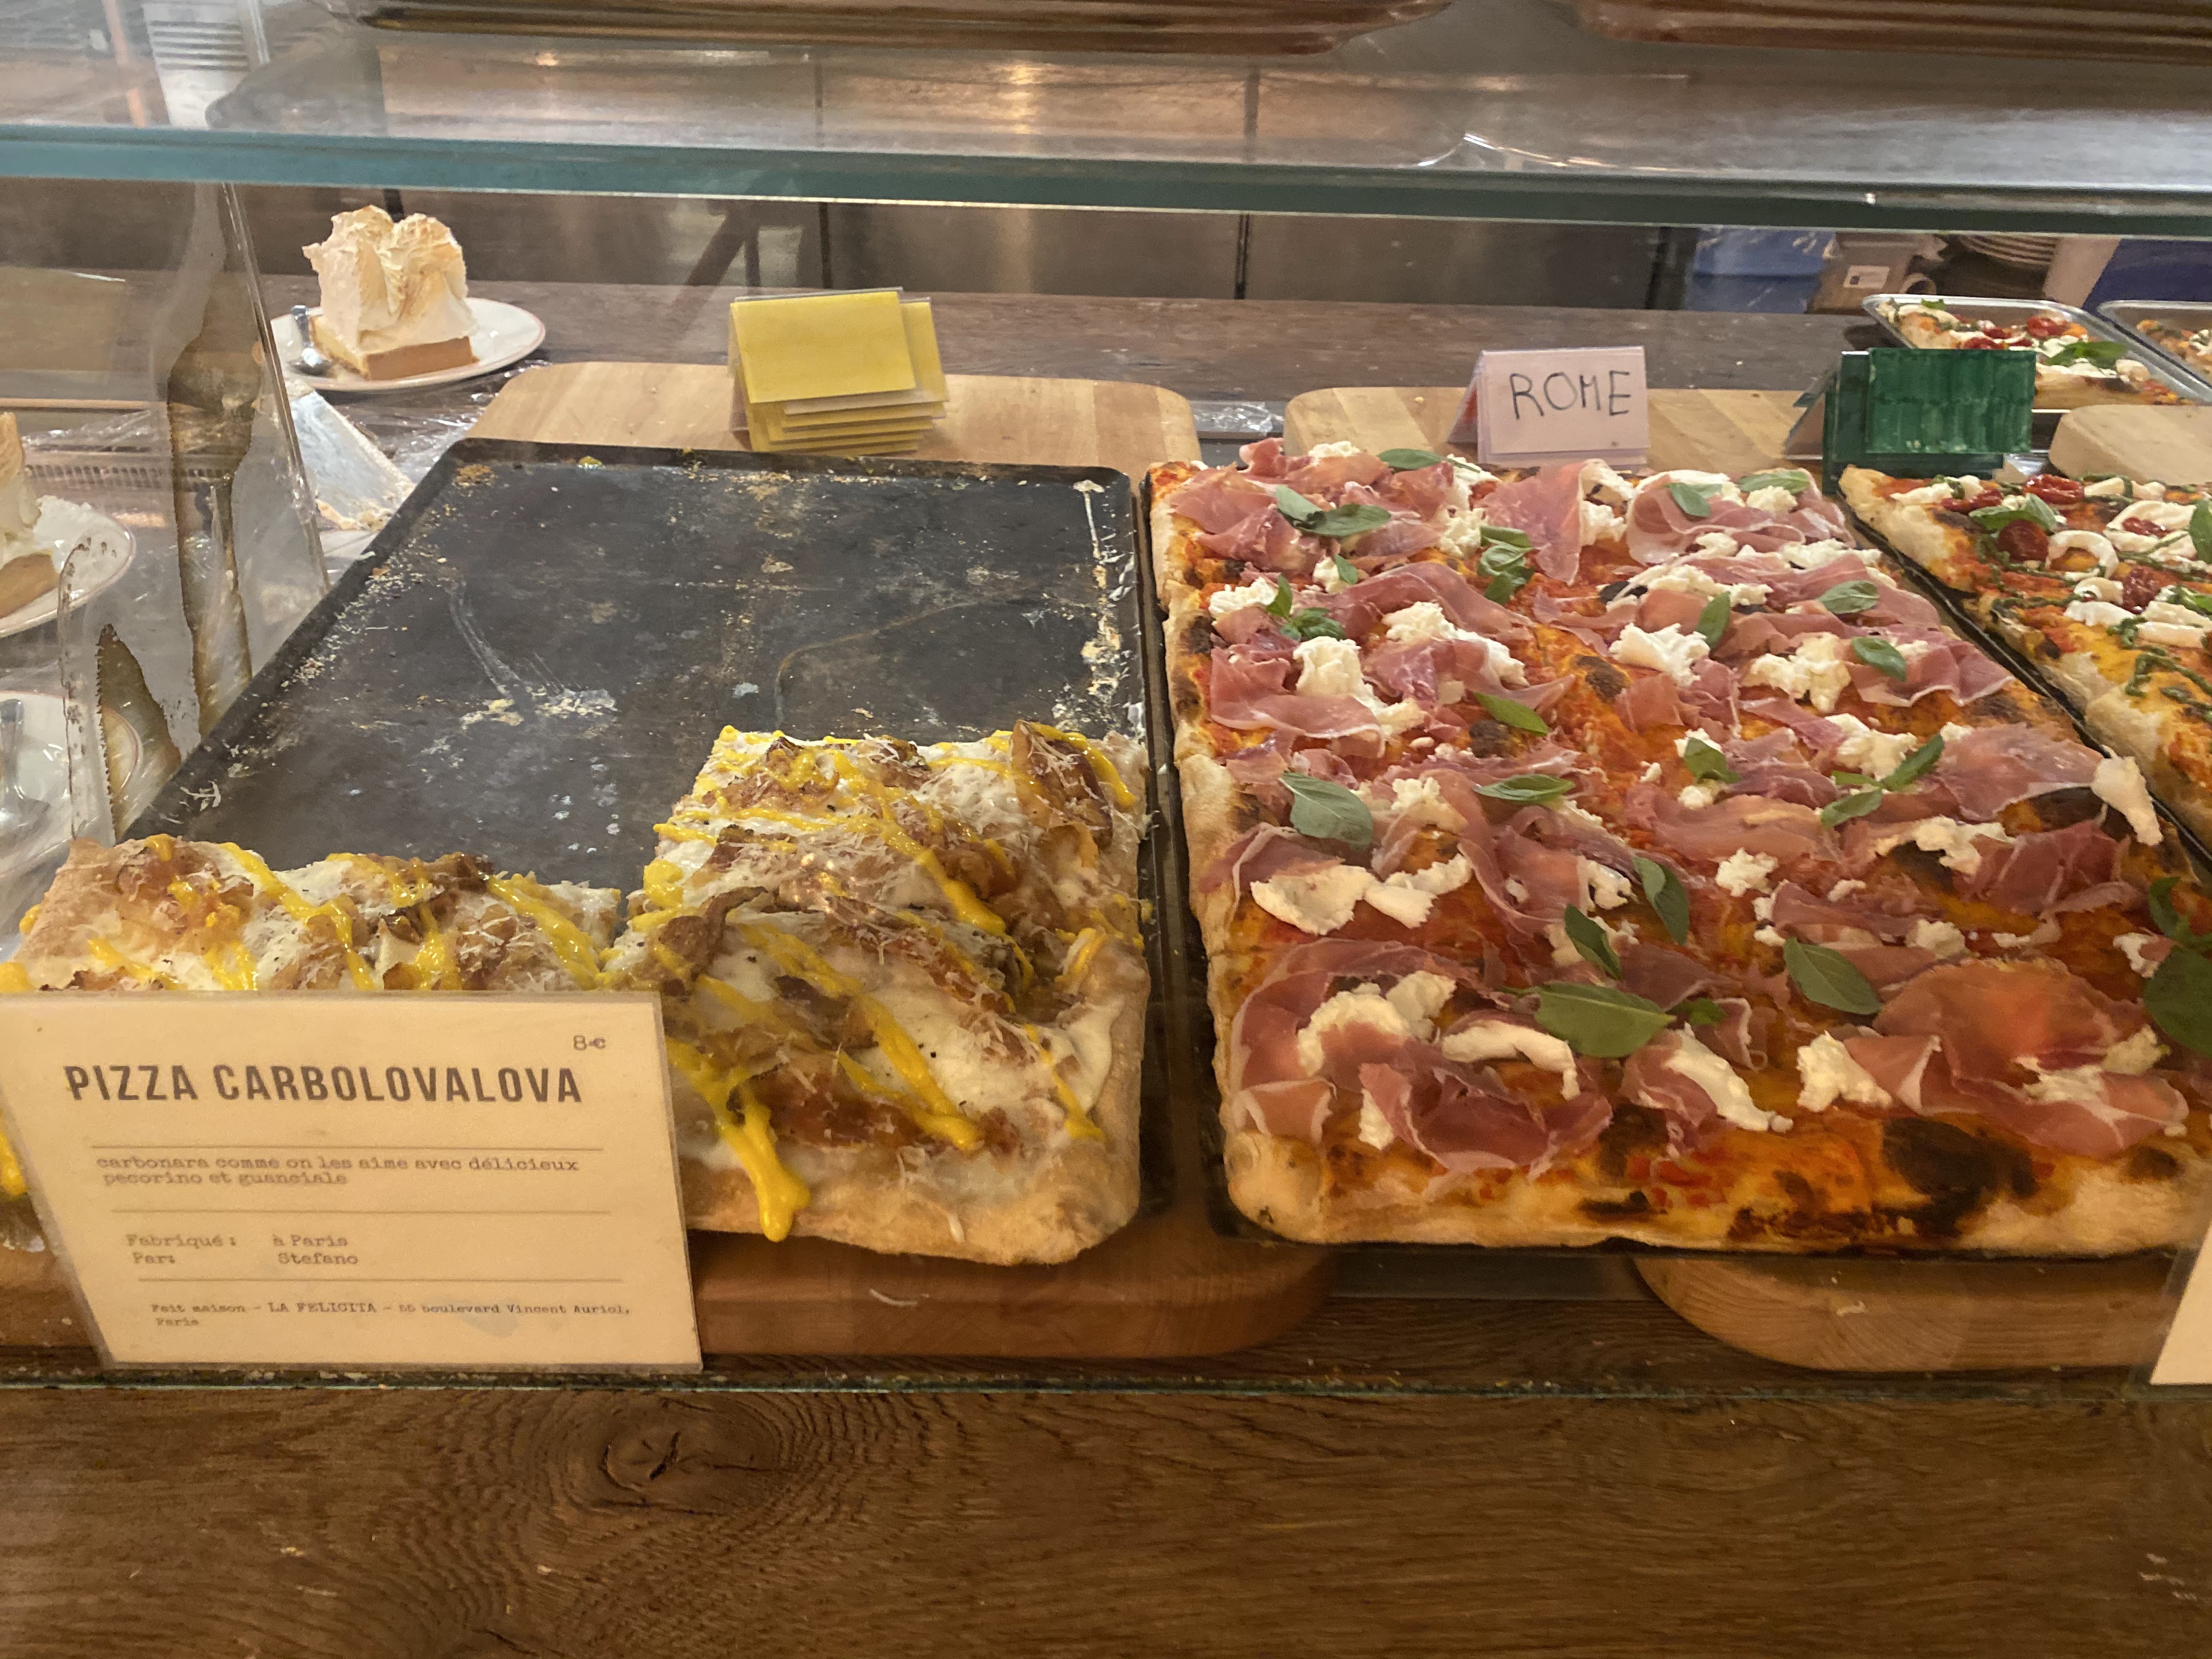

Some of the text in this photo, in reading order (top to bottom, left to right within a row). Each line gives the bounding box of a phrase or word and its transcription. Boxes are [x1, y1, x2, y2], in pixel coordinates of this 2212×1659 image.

[1510, 370, 1631, 420] ROME
[64, 1064, 583, 1102] PIZZA CARBOLOVALOVA
[95, 1155, 580, 1171] carbonara comme on les aime avec délicieux
[103, 1171, 347, 1187] pecorino et guanciale
[126, 1233, 223, 1249] Fabriqué
[272, 1233, 348, 1247] à Paris
[132, 1251, 176, 1265] Par:
[277, 1252, 359, 1265] Stefano
[268, 1302, 289, 1313] LA
[296, 1302, 377, 1313] FELICITA
[421, 1304, 499, 1313] boulevard
[507, 1305, 567, 1313] Vincent
[156, 1317, 200, 1327] Paris
